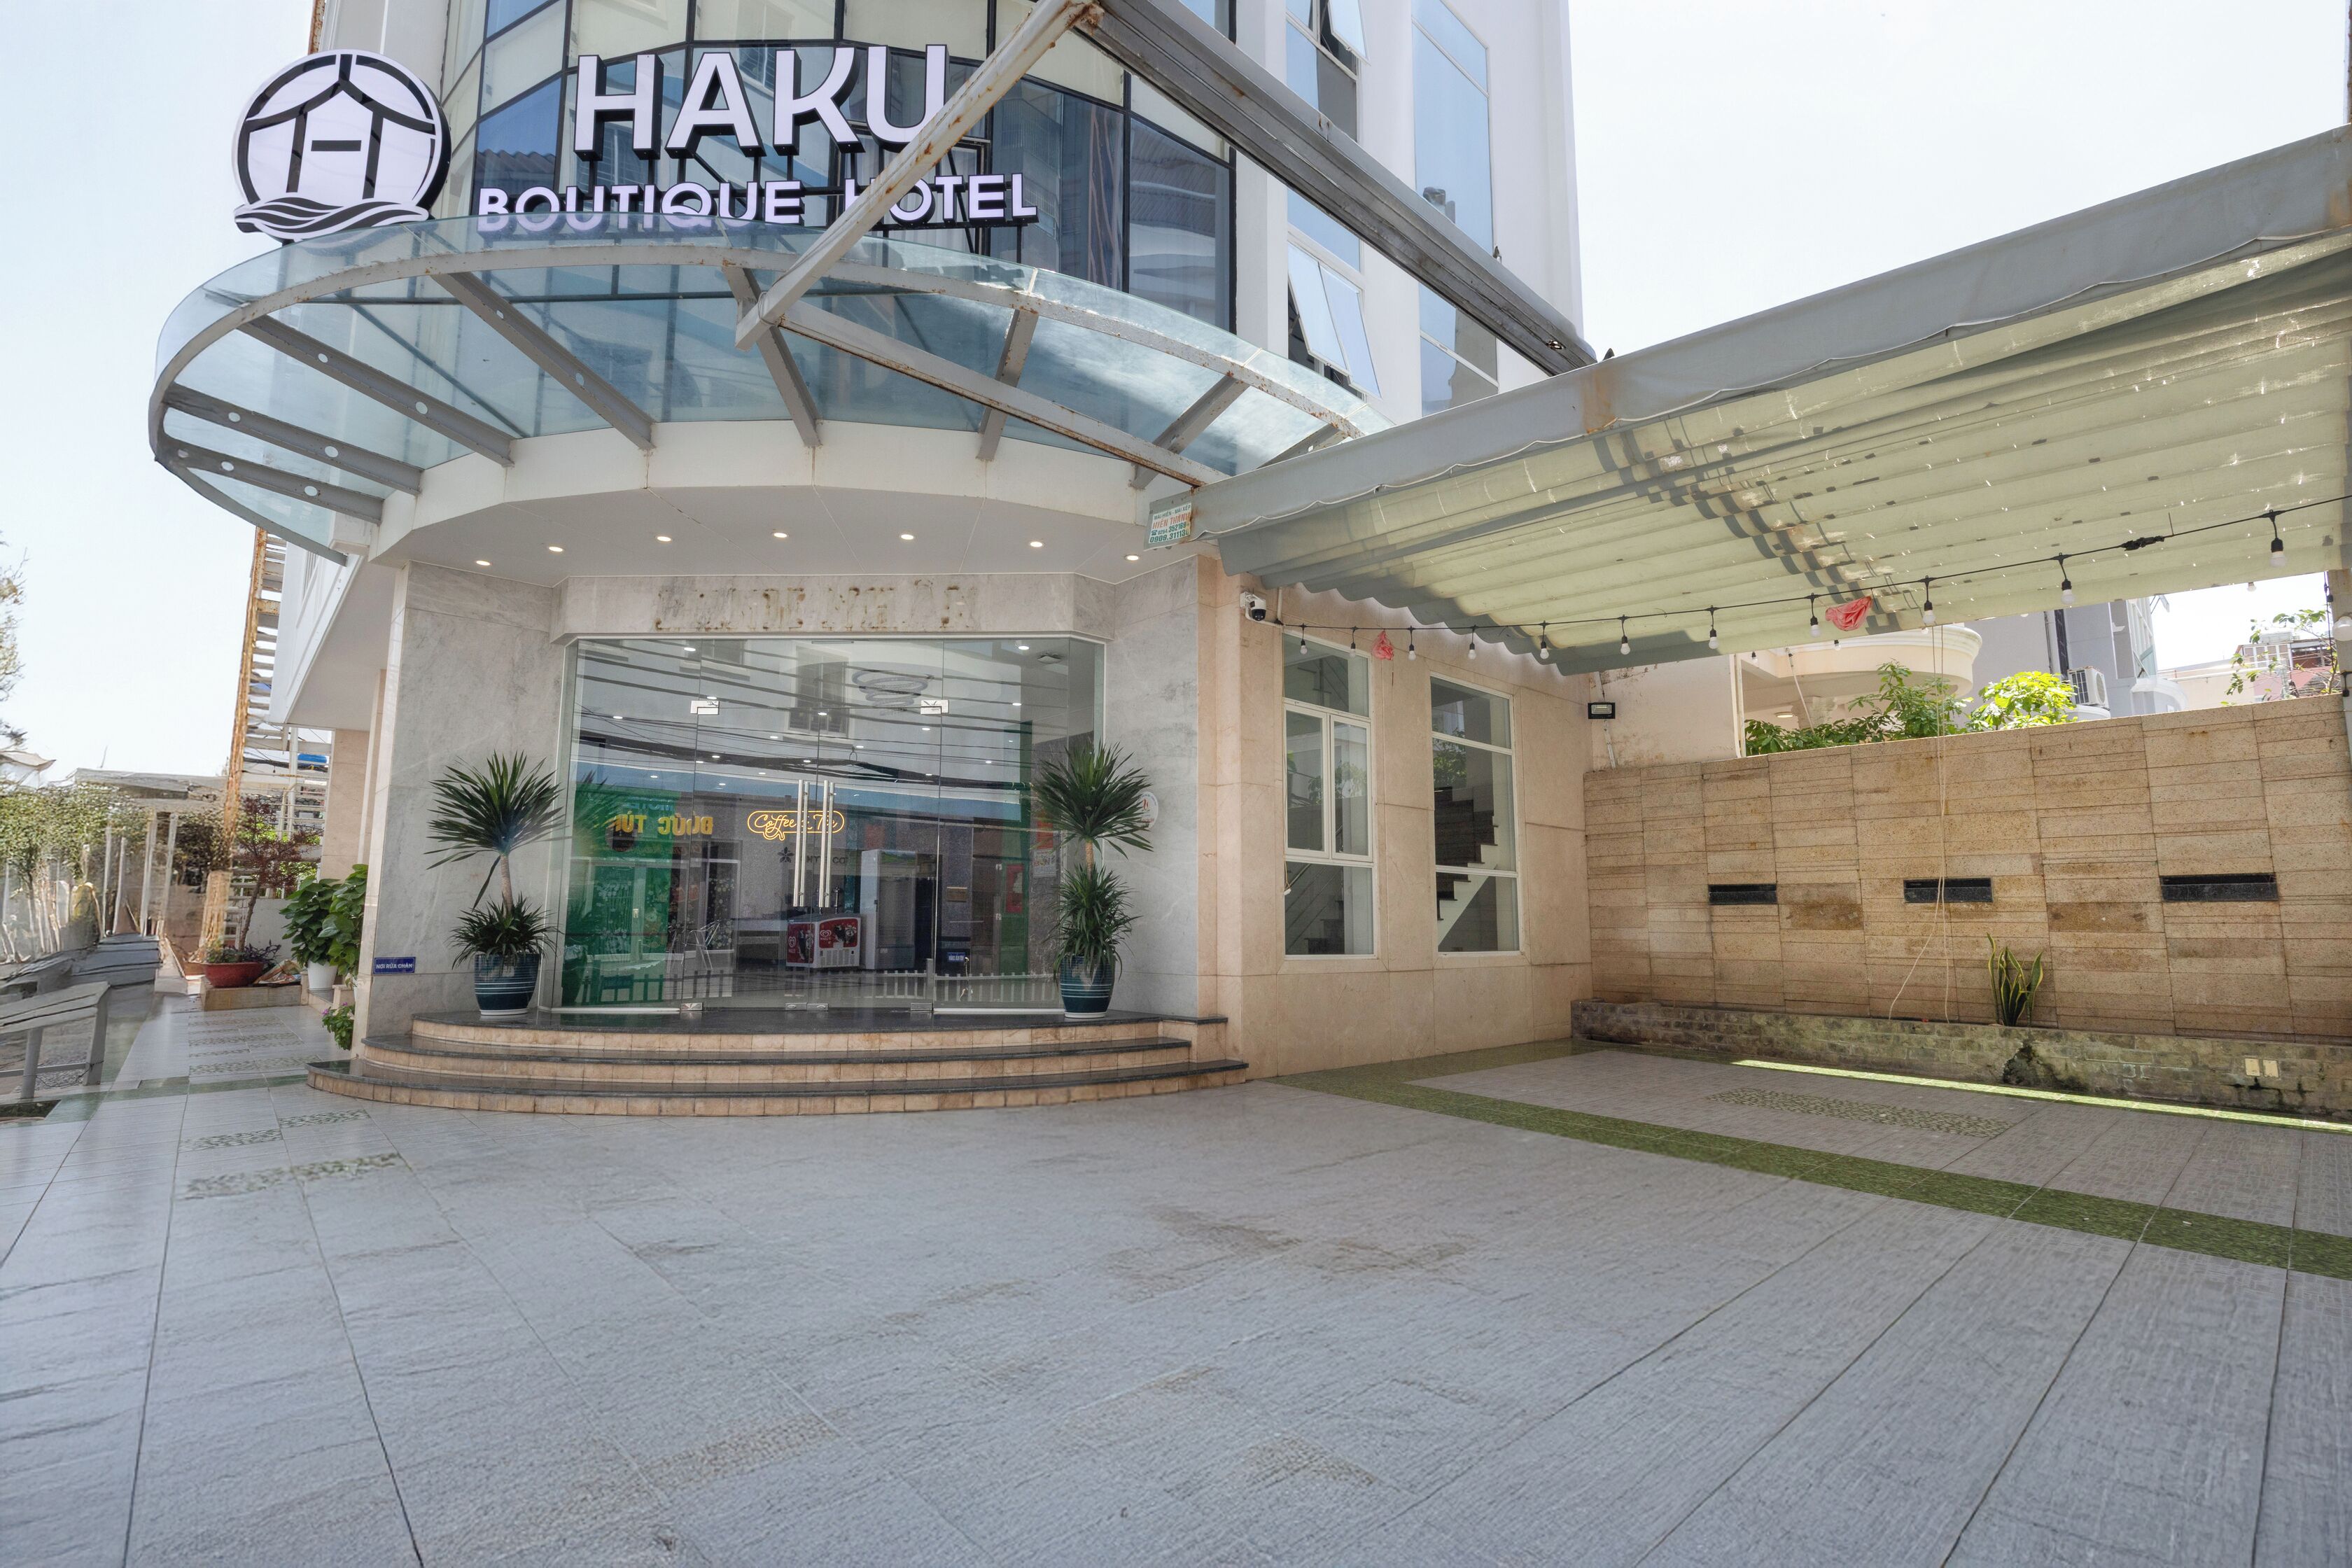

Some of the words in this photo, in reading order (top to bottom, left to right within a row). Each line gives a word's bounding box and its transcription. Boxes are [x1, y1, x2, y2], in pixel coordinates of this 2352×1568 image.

[573, 44, 948, 155] HAKU
[477, 180, 802, 233] BOUTIQUE
[754, 814, 797, 838] Coffee
